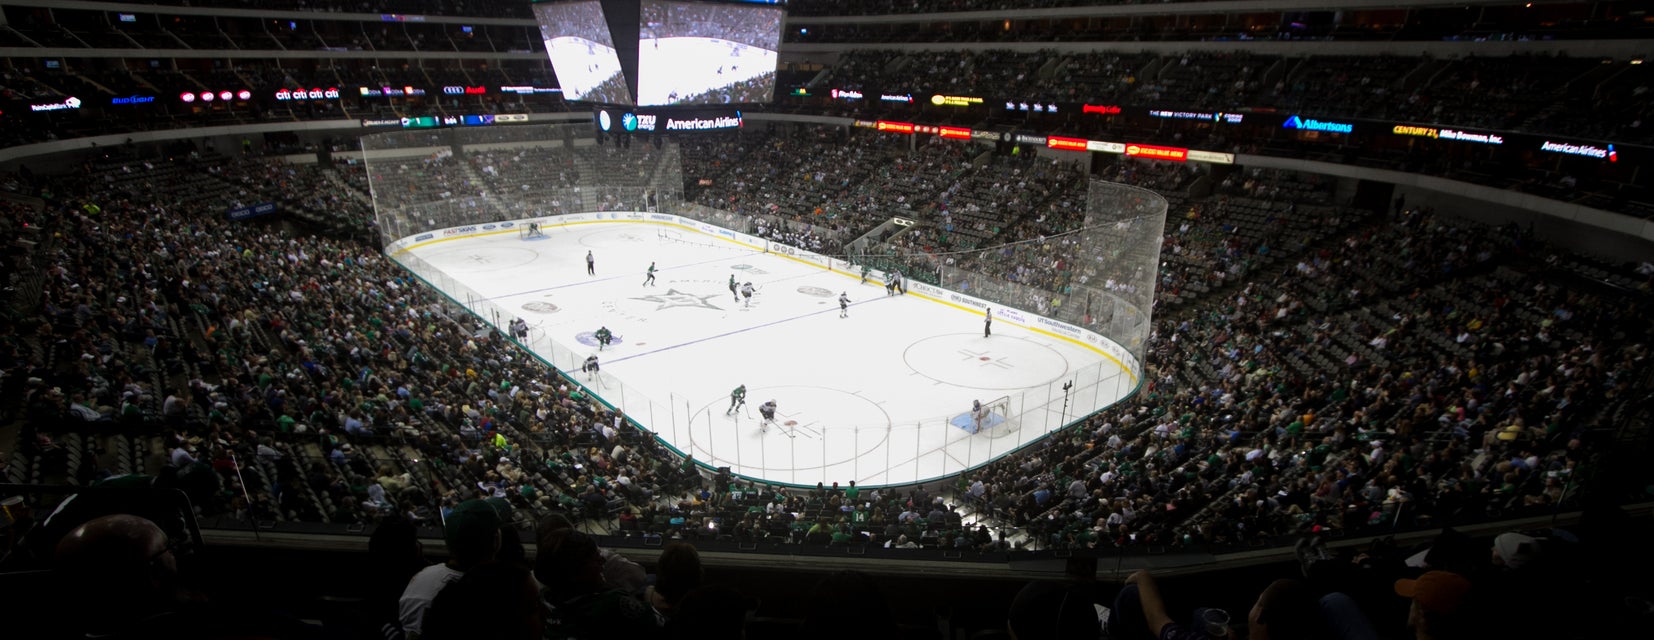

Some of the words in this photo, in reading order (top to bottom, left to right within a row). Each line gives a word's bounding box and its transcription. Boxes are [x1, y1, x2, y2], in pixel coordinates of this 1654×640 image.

[276, 90, 291, 100] citi
[292, 90, 308, 100] citi
[309, 90, 323, 99] citi
[325, 89, 339, 98] citi
[466, 86, 486, 94] Audi
[637, 115, 656, 124] TXU
[666, 118, 714, 130] American
[714, 116, 739, 128] Airlines
[1303, 118, 1353, 133] Albertsons
[1393, 125, 1428, 136] CENTURY
[1439, 129, 1457, 140] Mike
[1488, 134, 1503, 144] Inc.
[1541, 140, 1579, 154] American
[1578, 144, 1607, 158] Airlines
[1044, 319, 1082, 335] Southwestern
[855, 514, 865, 522] 14
